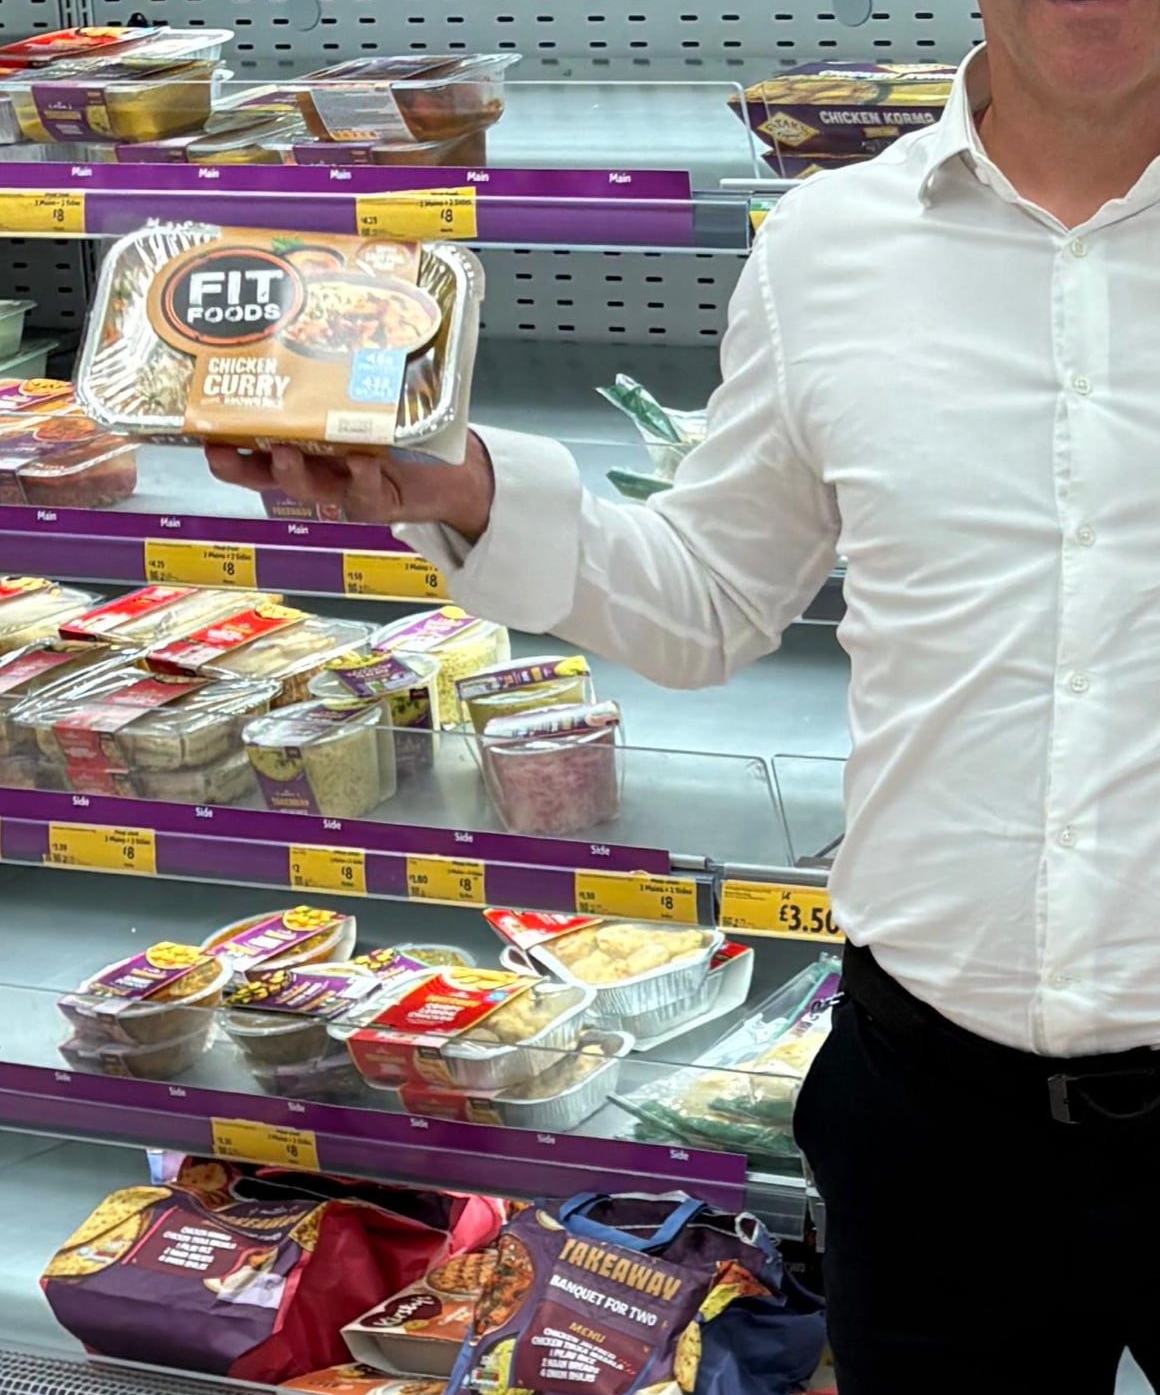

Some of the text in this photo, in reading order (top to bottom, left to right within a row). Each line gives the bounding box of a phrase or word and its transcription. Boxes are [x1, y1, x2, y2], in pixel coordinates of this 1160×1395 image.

[819, 110, 935, 125] CHICKEN KORMA
[189, 270, 285, 306] FIT
[186, 303, 281, 323] FOODS
[208, 356, 278, 374] CHICKEN
[203, 373, 291, 398] CURRY
[559, 1238, 682, 1301] TAKEAWAY
[550, 1275, 658, 1326] BANQUET FOR TWO
[568, 1321, 606, 1343] MENU
